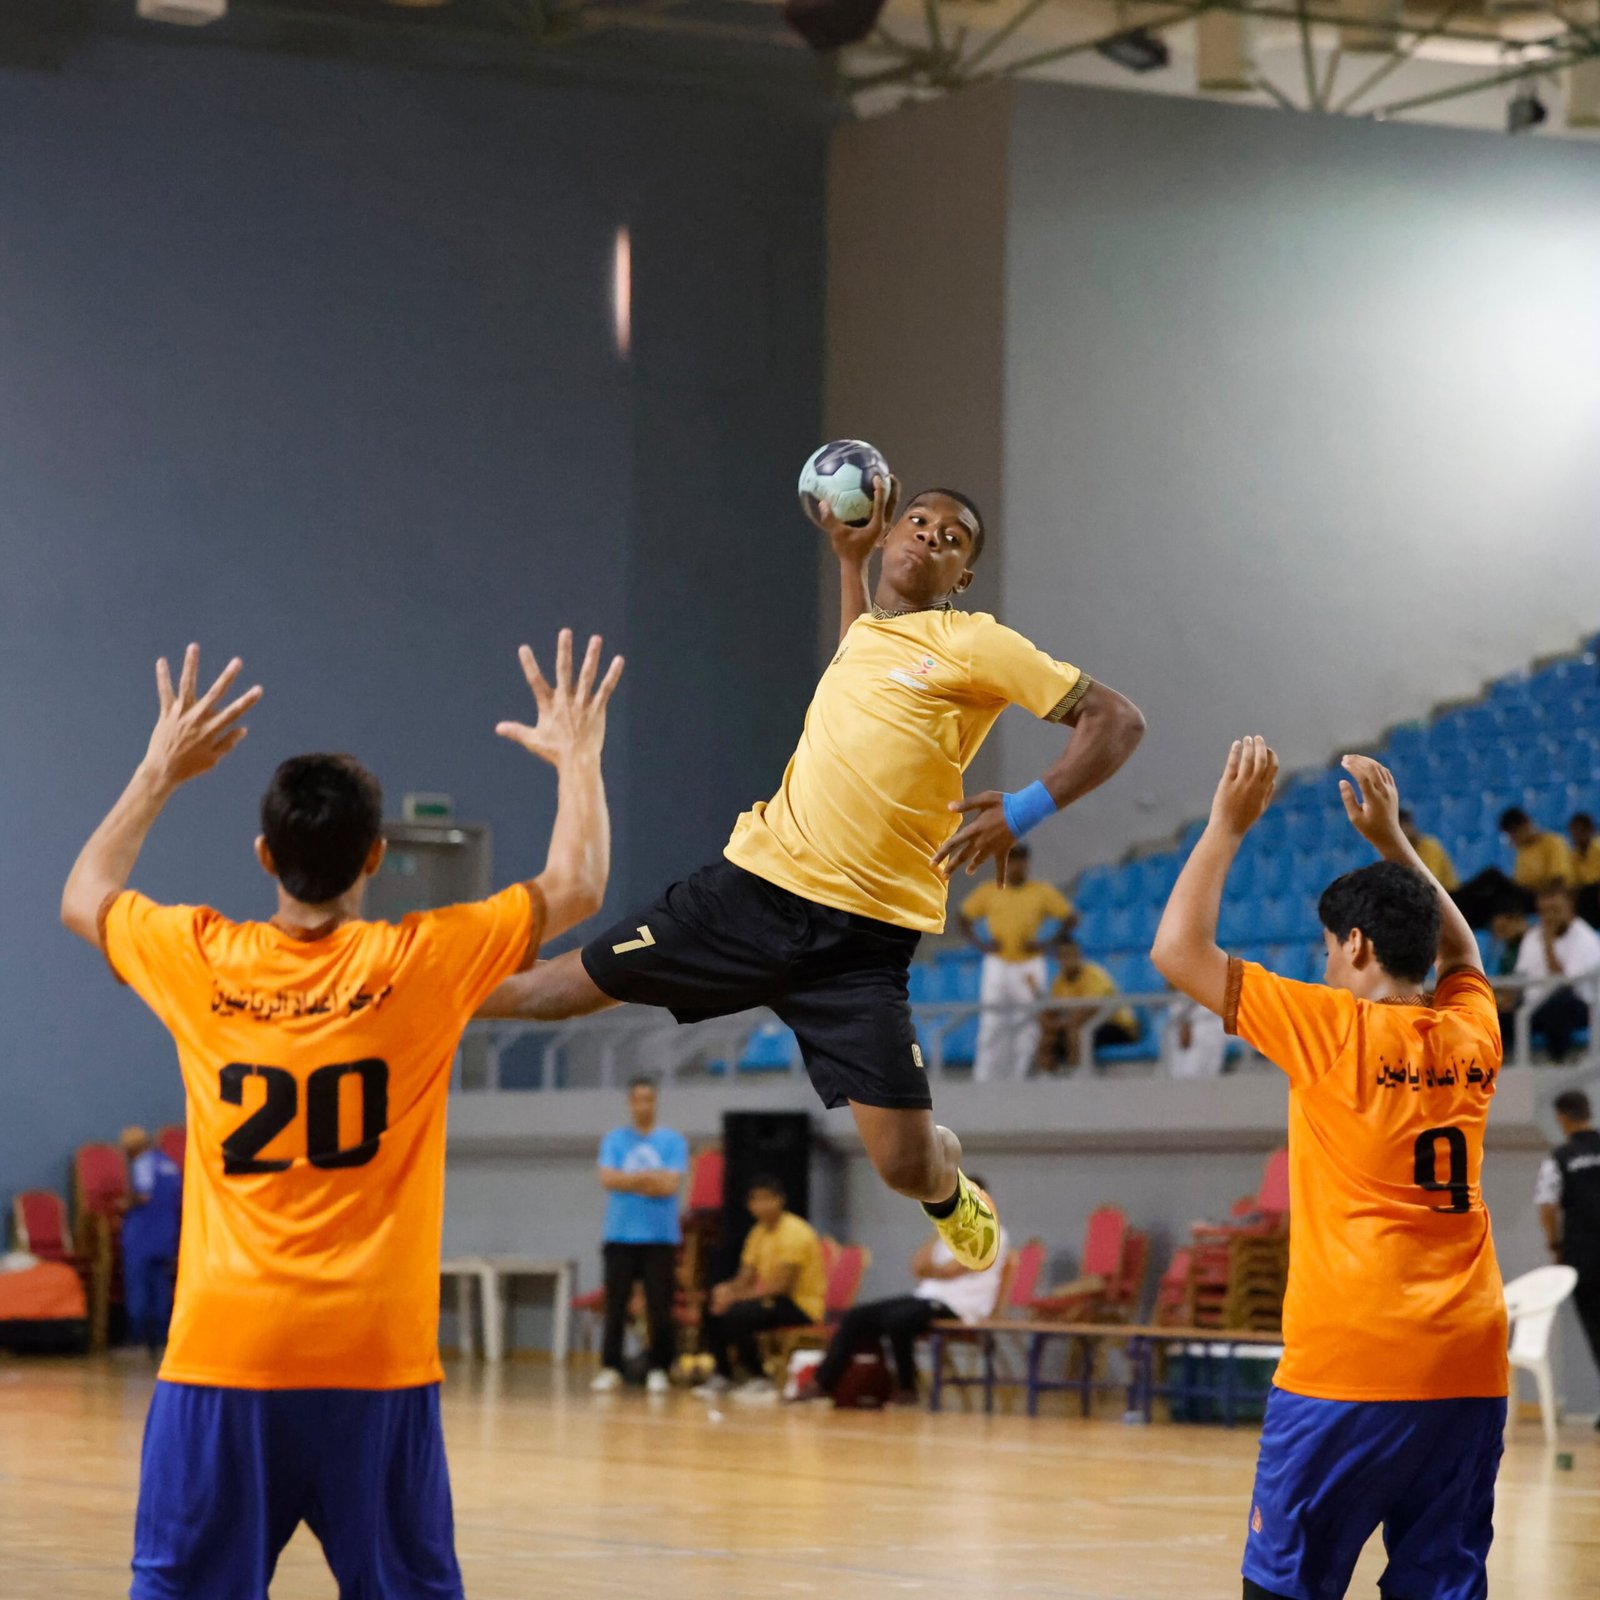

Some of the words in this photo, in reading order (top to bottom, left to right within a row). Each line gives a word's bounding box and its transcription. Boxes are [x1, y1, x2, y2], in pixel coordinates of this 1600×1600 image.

[612, 925, 656, 954] 7
[1461, 1058, 1495, 1090] مركز
[219, 1057, 389, 1175] 20
[1414, 1126, 1470, 1213] 9
